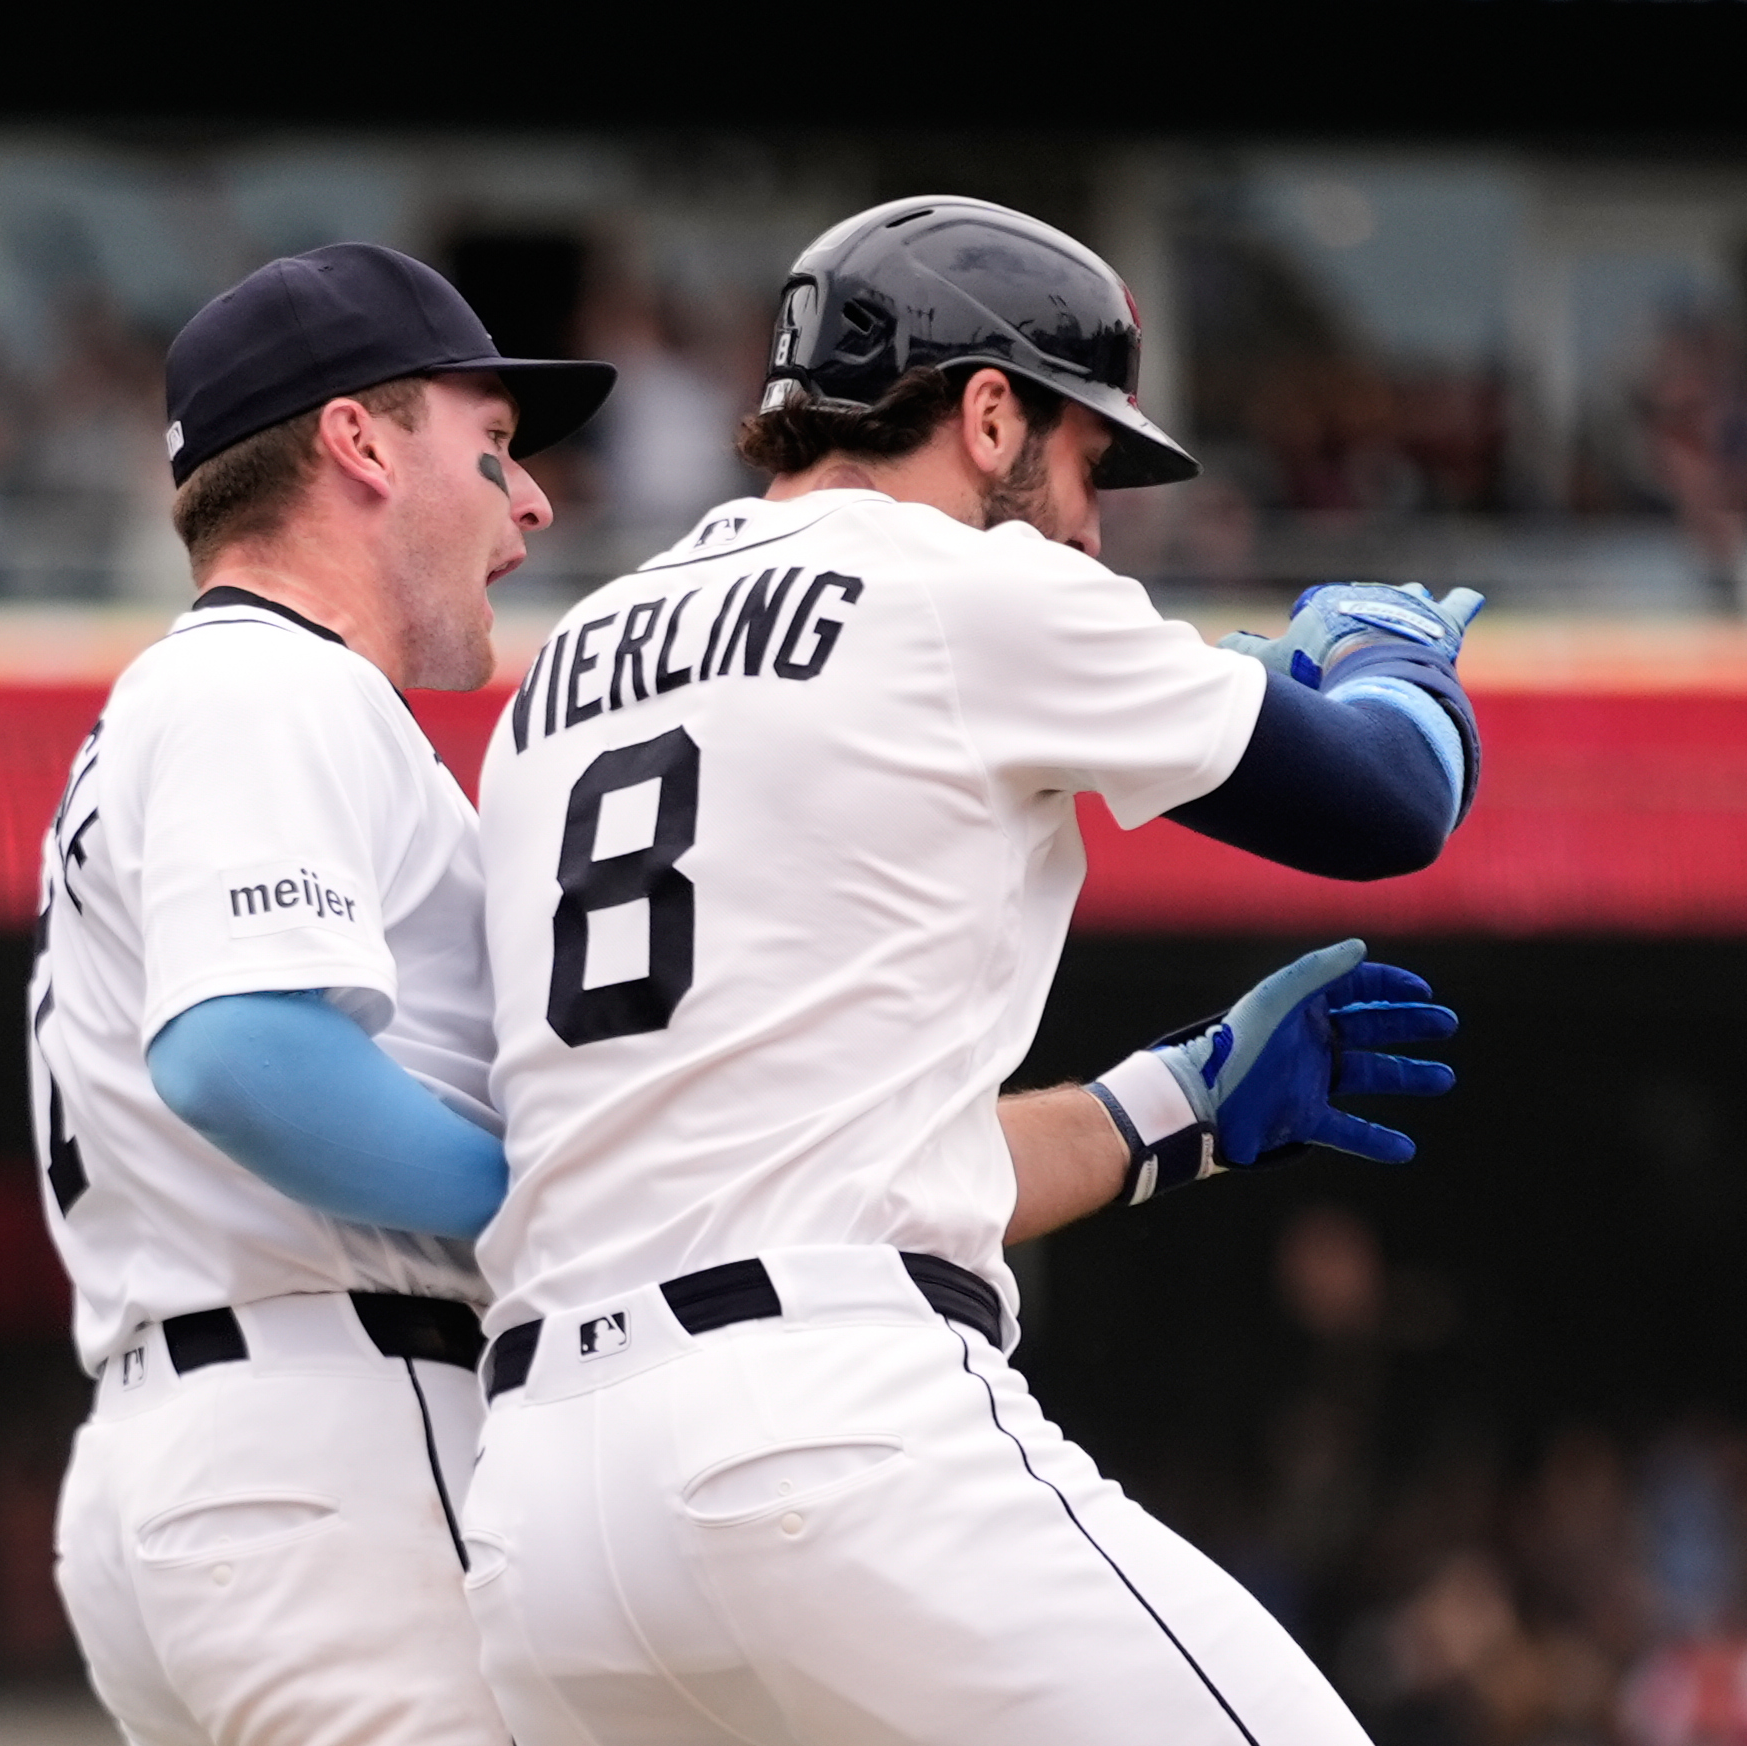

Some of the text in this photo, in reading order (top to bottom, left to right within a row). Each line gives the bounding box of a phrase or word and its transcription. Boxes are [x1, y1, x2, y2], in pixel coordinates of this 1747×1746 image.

[775, 333, 792, 367] 8
[512, 567, 864, 755] VIERLING
[229, 868, 356, 923] meijer
[546, 724, 701, 1049] 8
